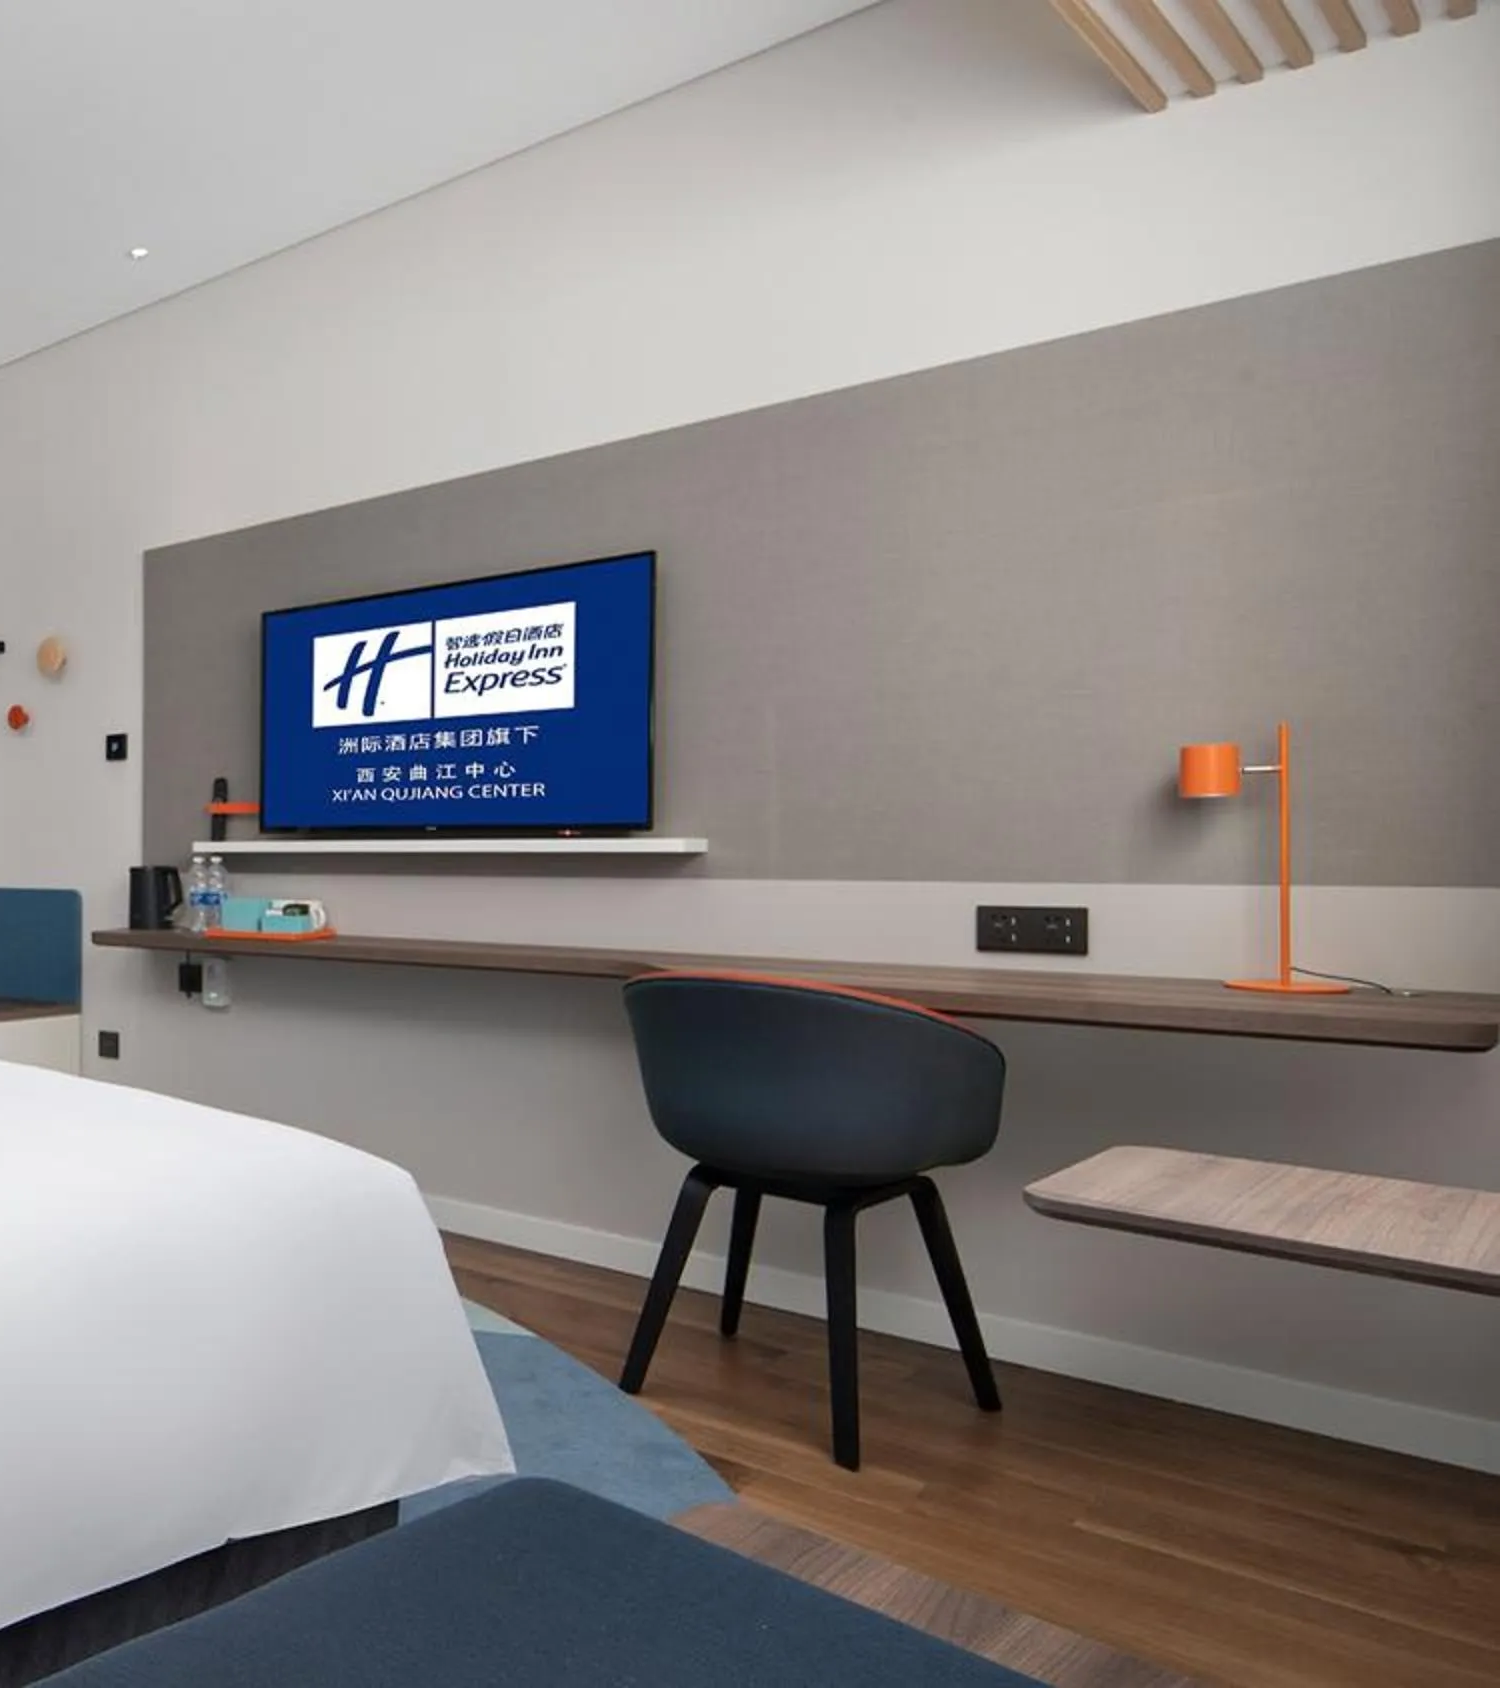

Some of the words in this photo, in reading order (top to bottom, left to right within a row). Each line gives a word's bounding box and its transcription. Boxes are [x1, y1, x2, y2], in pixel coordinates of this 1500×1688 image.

[444, 648, 526, 668] Holiday
[528, 643, 564, 660] Inn
[444, 665, 564, 697] Express
[338, 725, 540, 755] 洲际酒店集团旗下
[356, 761, 517, 783] 西安曲江中心
[331, 787, 377, 802] XI'AN
[381, 784, 464, 802] QUJIANG
[467, 782, 546, 799] CENTER
